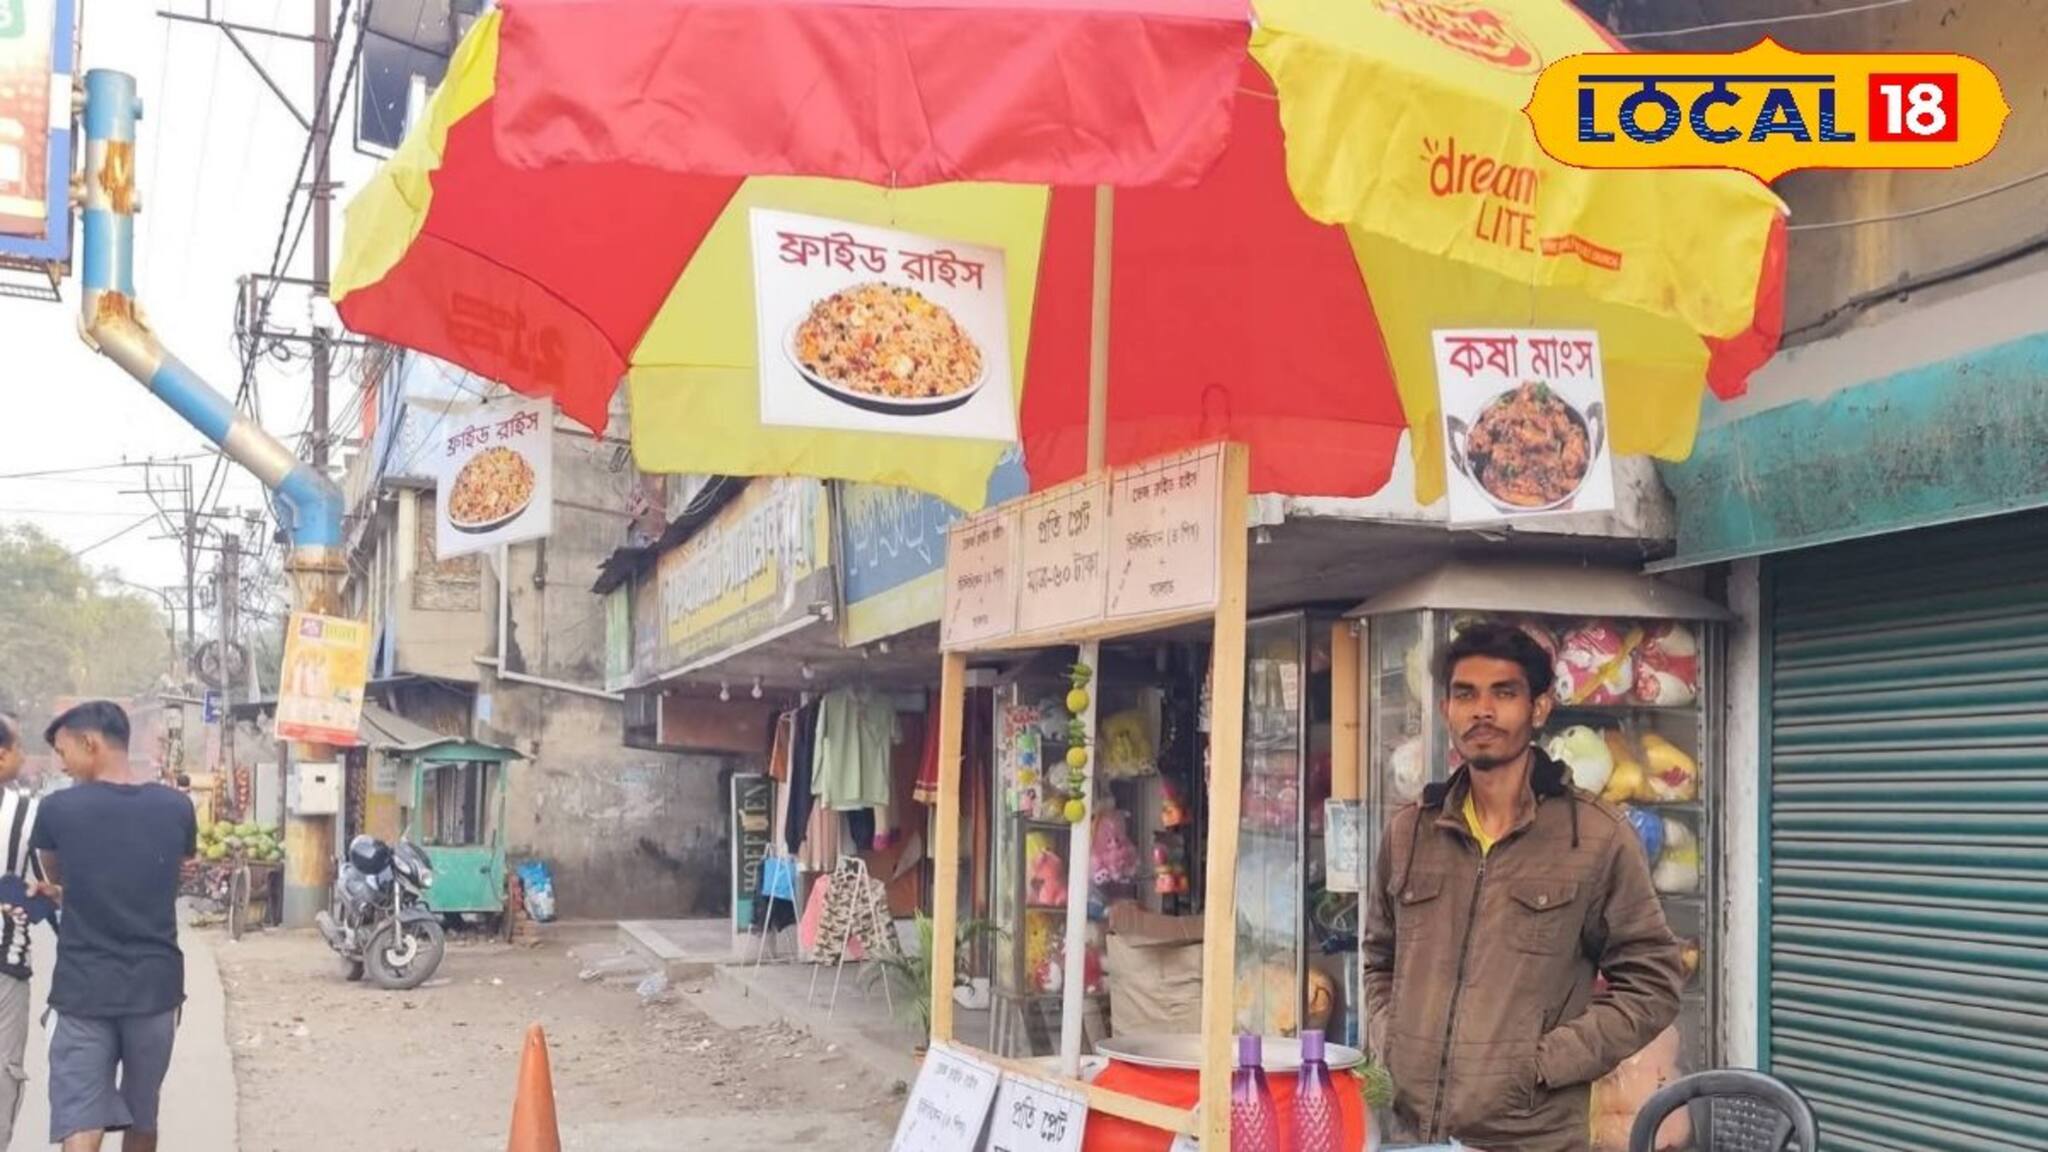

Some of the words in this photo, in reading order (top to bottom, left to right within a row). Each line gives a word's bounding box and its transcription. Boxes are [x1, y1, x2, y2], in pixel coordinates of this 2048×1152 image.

[1475, 200, 1536, 253] LITE
[777, 231, 888, 274] ফ্রাইড
[898, 249, 985, 290] রাইস
[1445, 335, 1518, 378] কষা
[1528, 337, 1593, 379] মাংস
[446, 425, 490, 457] ফ্রাইড
[495, 411, 539, 440] রাইস
